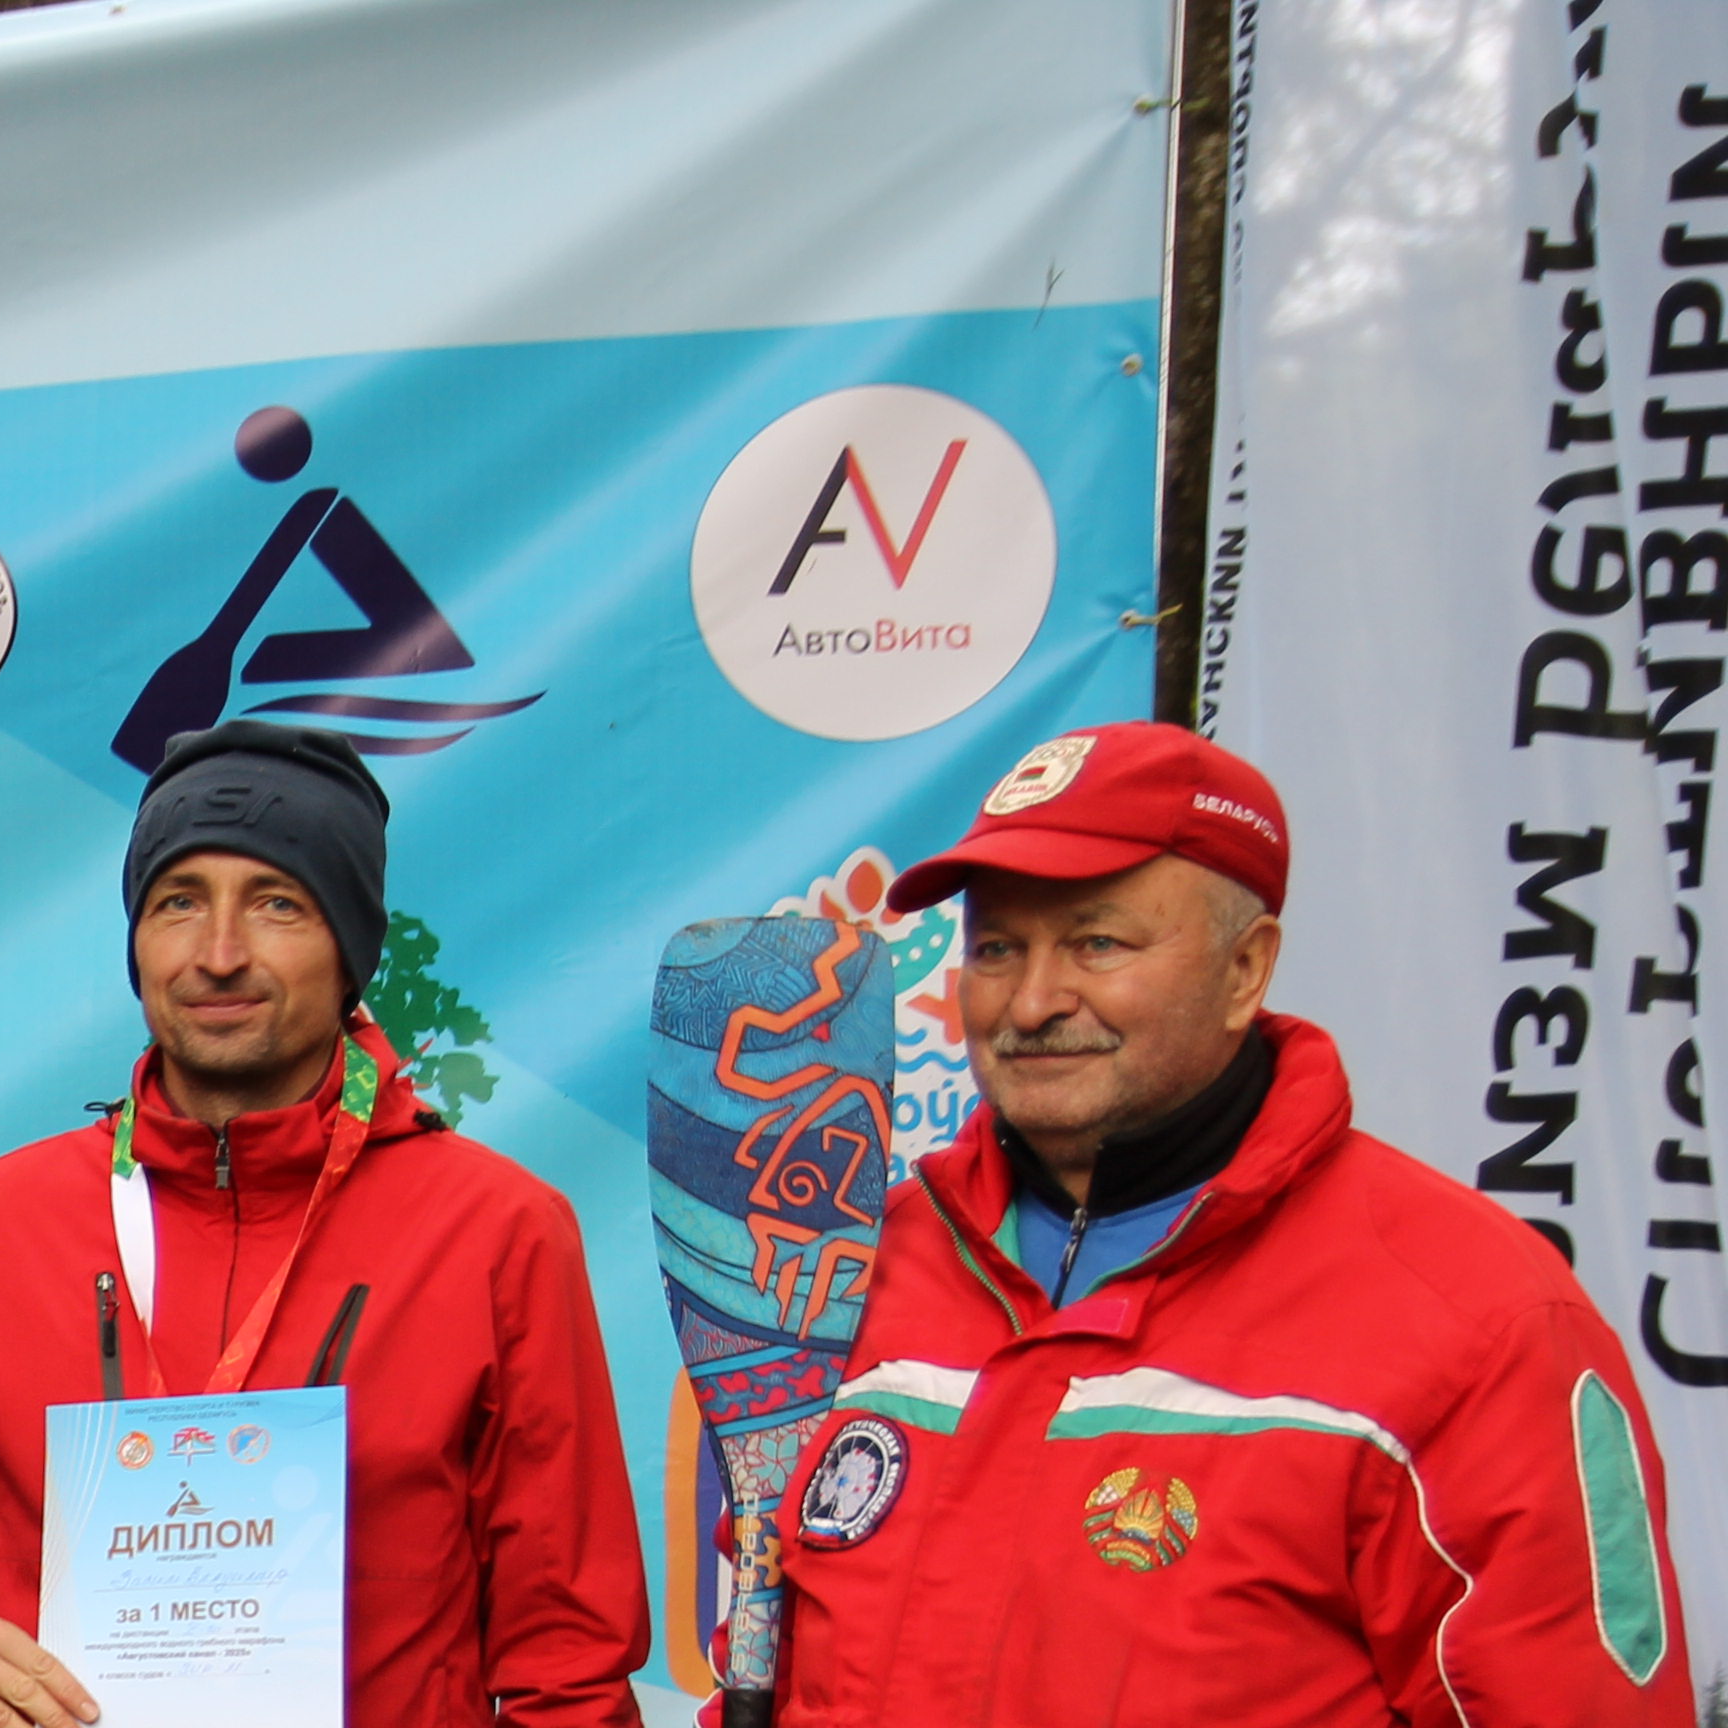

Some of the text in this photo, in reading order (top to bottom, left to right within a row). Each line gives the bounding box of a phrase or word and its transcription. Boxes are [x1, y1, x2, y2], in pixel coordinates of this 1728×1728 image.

[772, 618, 971, 659] АвтоВита
[107, 1518, 274, 1560] ДИПЛОМ
[116, 1598, 260, 1624] за 1 МЕСТО
